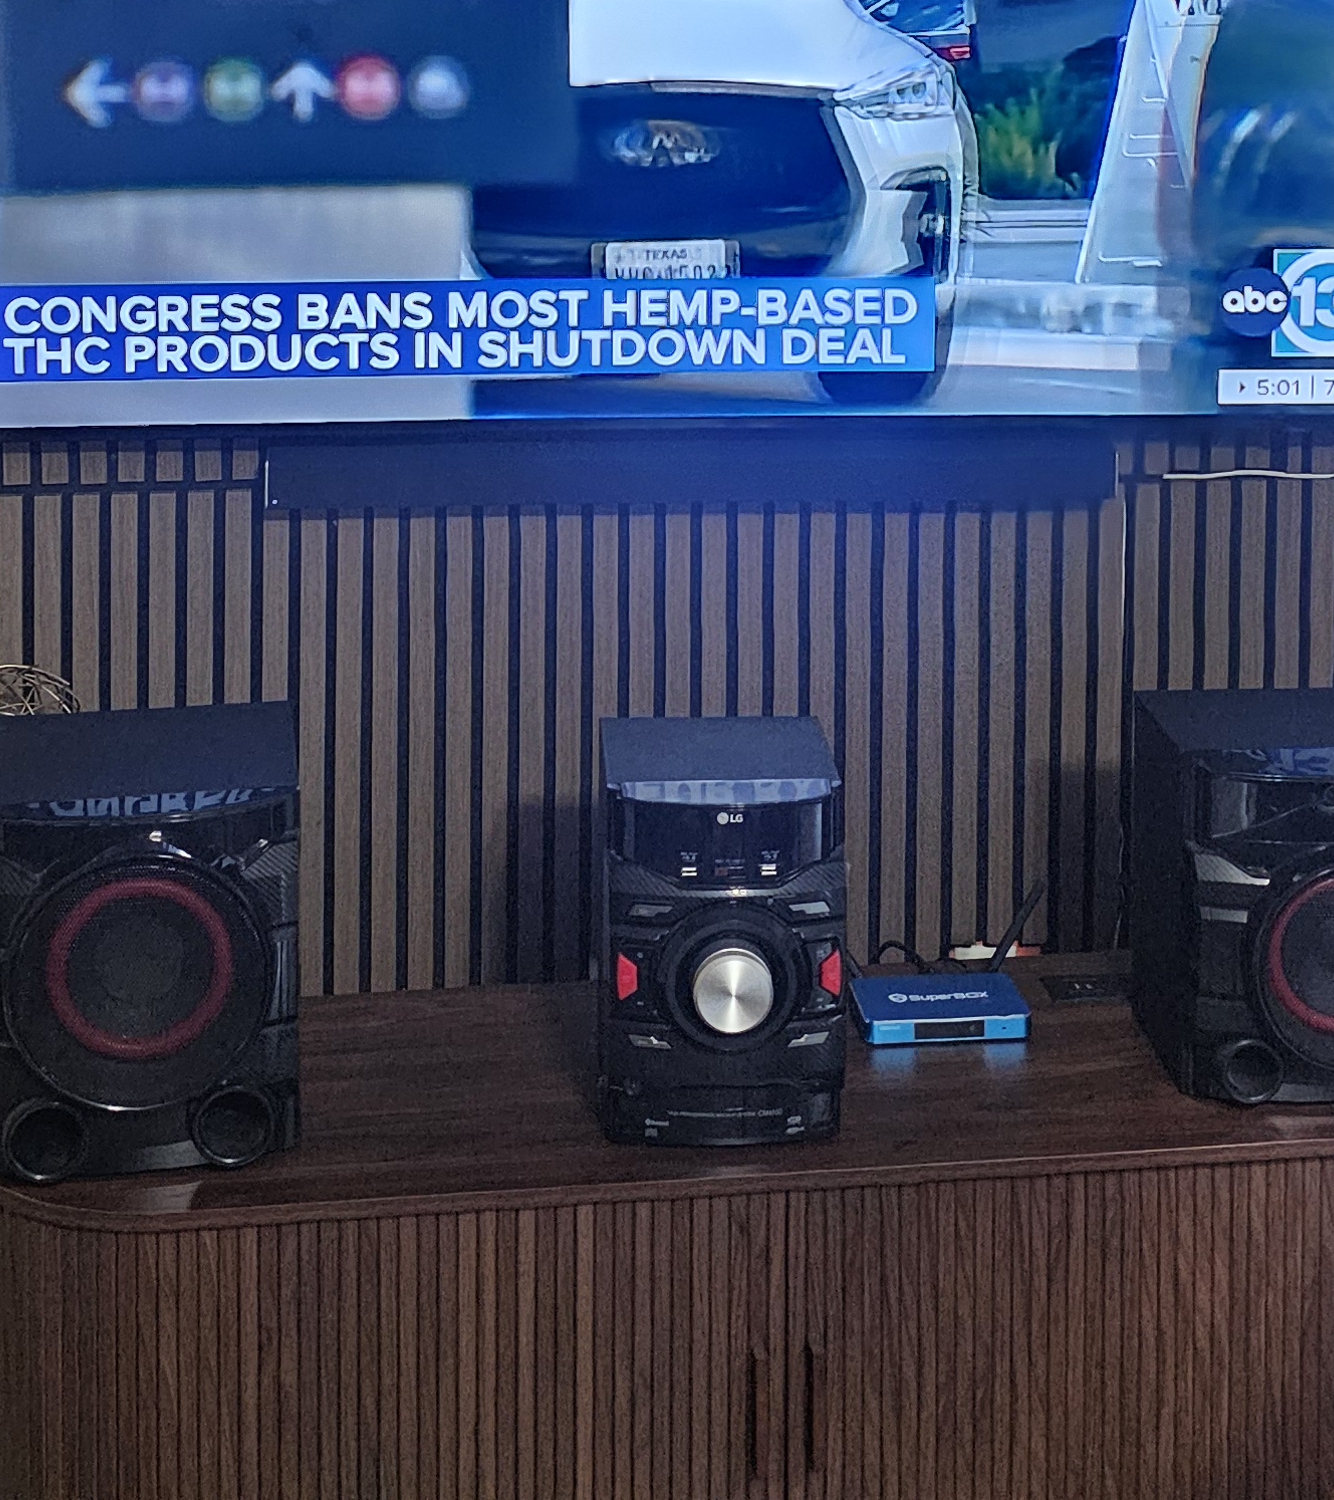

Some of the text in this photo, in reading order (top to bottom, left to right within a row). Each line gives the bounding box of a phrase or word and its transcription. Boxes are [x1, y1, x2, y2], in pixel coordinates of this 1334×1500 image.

[645, 248, 688, 261] TEXAS
[3, 288, 918, 334] CONGRESS BANS MOST HEMP-BASED
[1222, 285, 1288, 313] abc
[2, 327, 907, 375] THC PRODUCTS IN SHUTDOWN DEAL
[1257, 379, 1300, 396] 5:01
